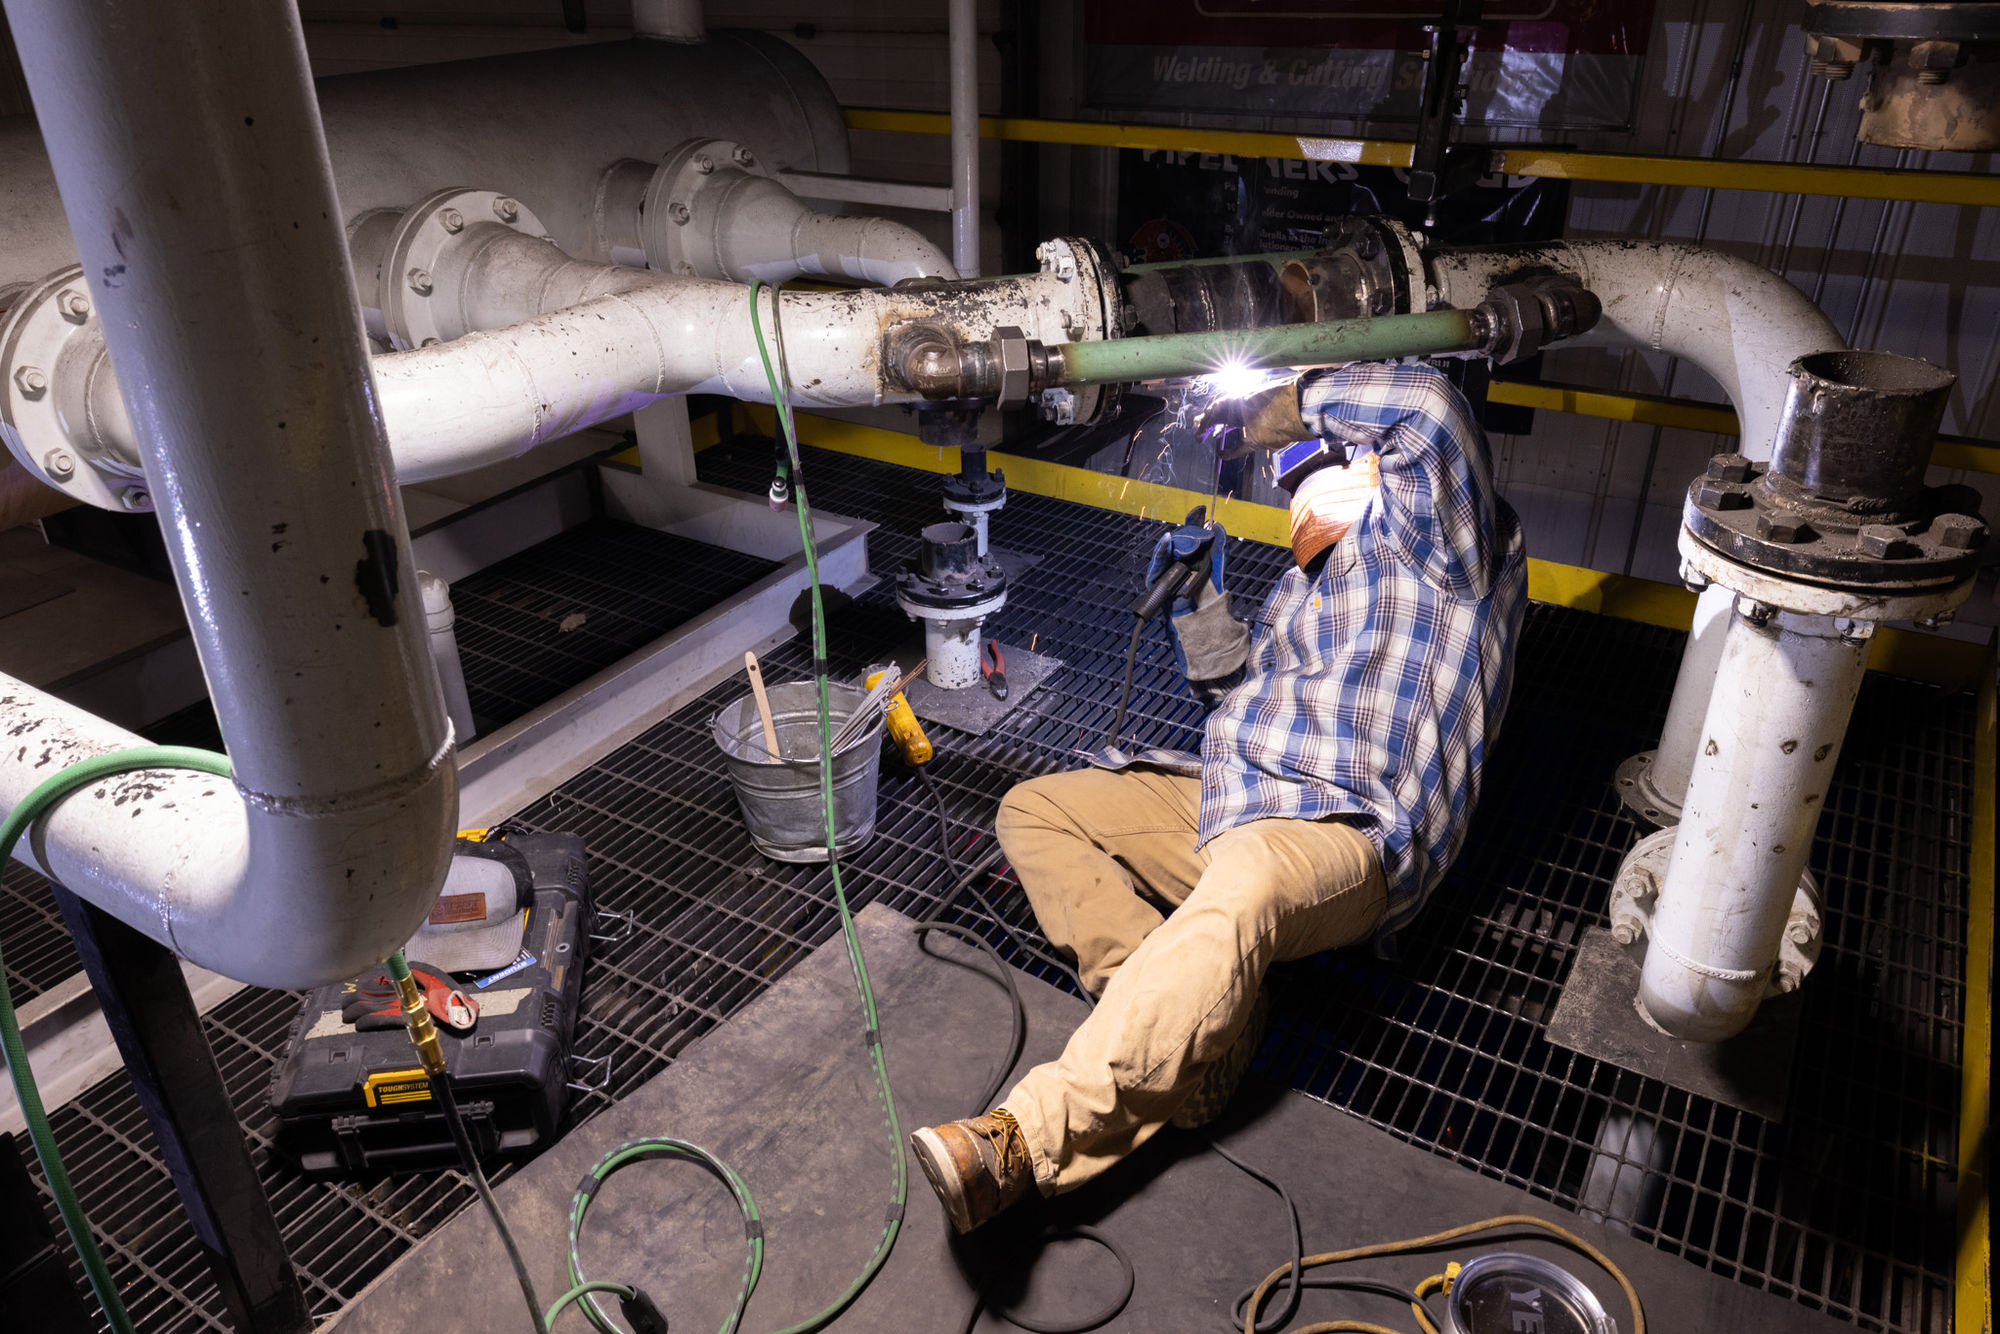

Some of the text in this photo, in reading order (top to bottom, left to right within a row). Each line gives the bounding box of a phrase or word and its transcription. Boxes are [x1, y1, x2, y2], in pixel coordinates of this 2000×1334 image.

[1152, 55, 1250, 90] Welding
[1257, 60, 1279, 86] &
[1288, 58, 1386, 93] Cutting
